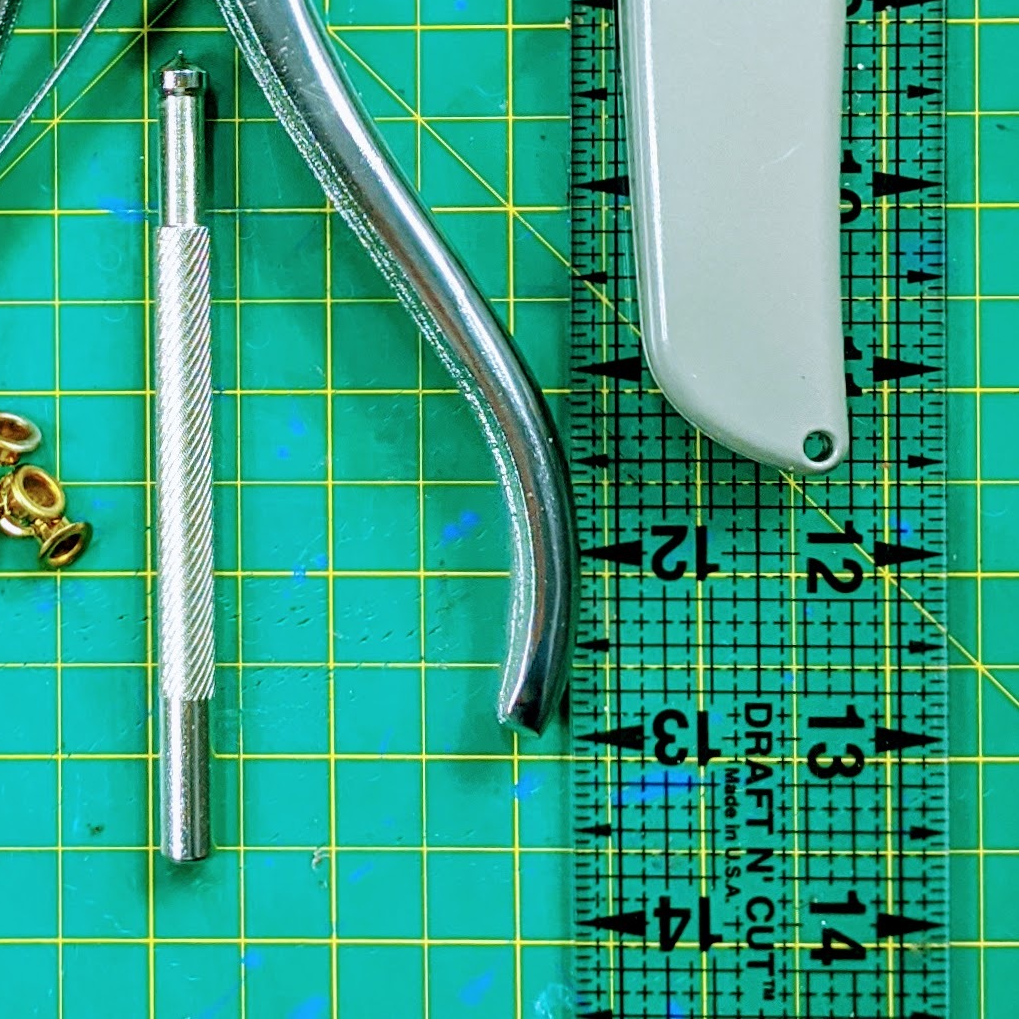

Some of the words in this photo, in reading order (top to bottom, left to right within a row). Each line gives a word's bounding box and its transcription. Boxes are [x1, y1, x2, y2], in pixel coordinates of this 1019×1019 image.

[651, 524, 720, 581] 12
[807, 520, 863, 593] 12
[652, 709, 722, 766] 13
[807, 704, 865, 780] 13
[724, 767, 741, 819] Made
[744, 702, 774, 835] DRAFT
[725, 824, 741, 841] in
[725, 847, 741, 903] U.S.A.
[652, 895, 723, 952] 14
[810, 889, 867, 966] 14
